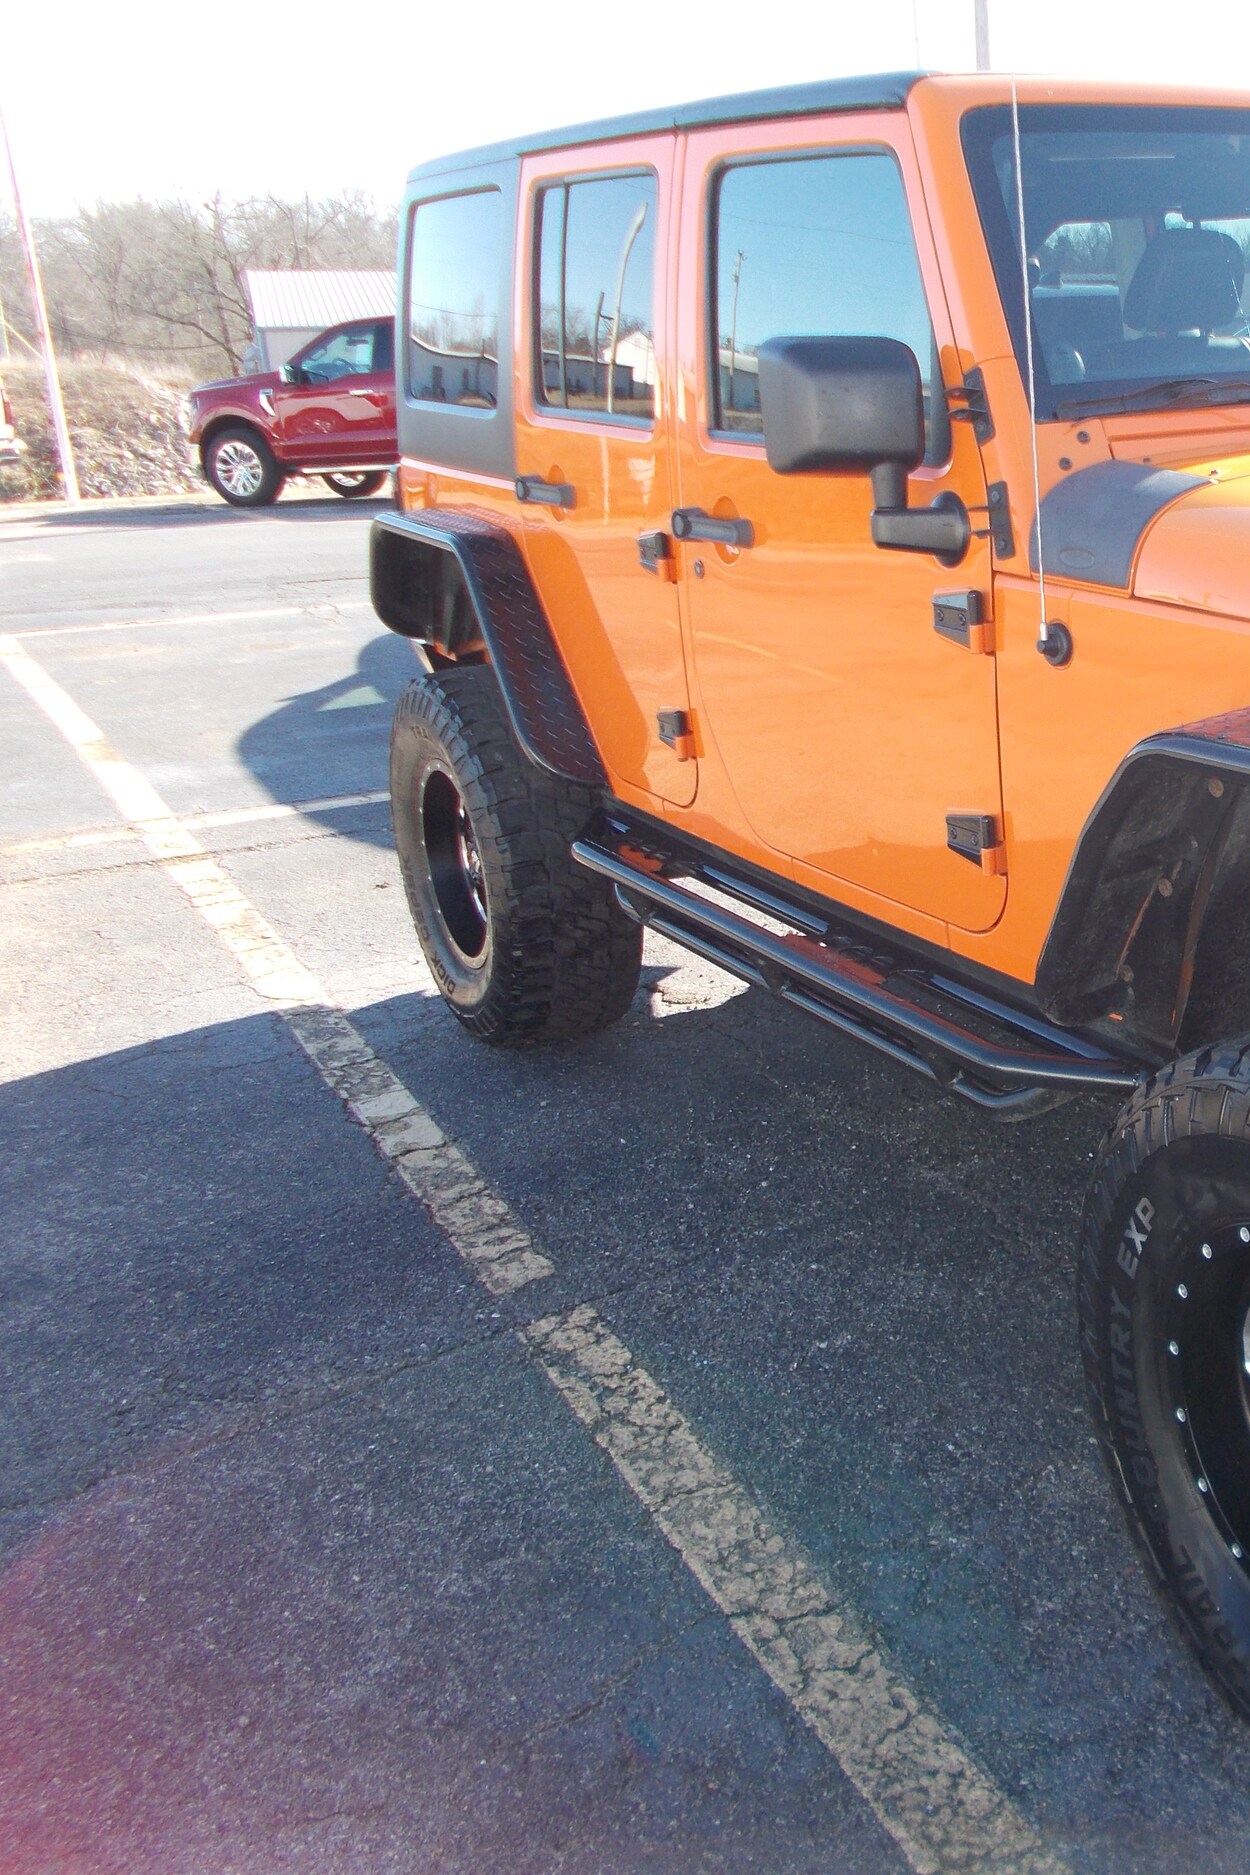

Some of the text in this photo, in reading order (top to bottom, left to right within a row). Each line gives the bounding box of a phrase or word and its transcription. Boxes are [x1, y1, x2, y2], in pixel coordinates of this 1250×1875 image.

[402, 854, 457, 996] DICK CEPEK
[1116, 1197, 1156, 1280] EXP
